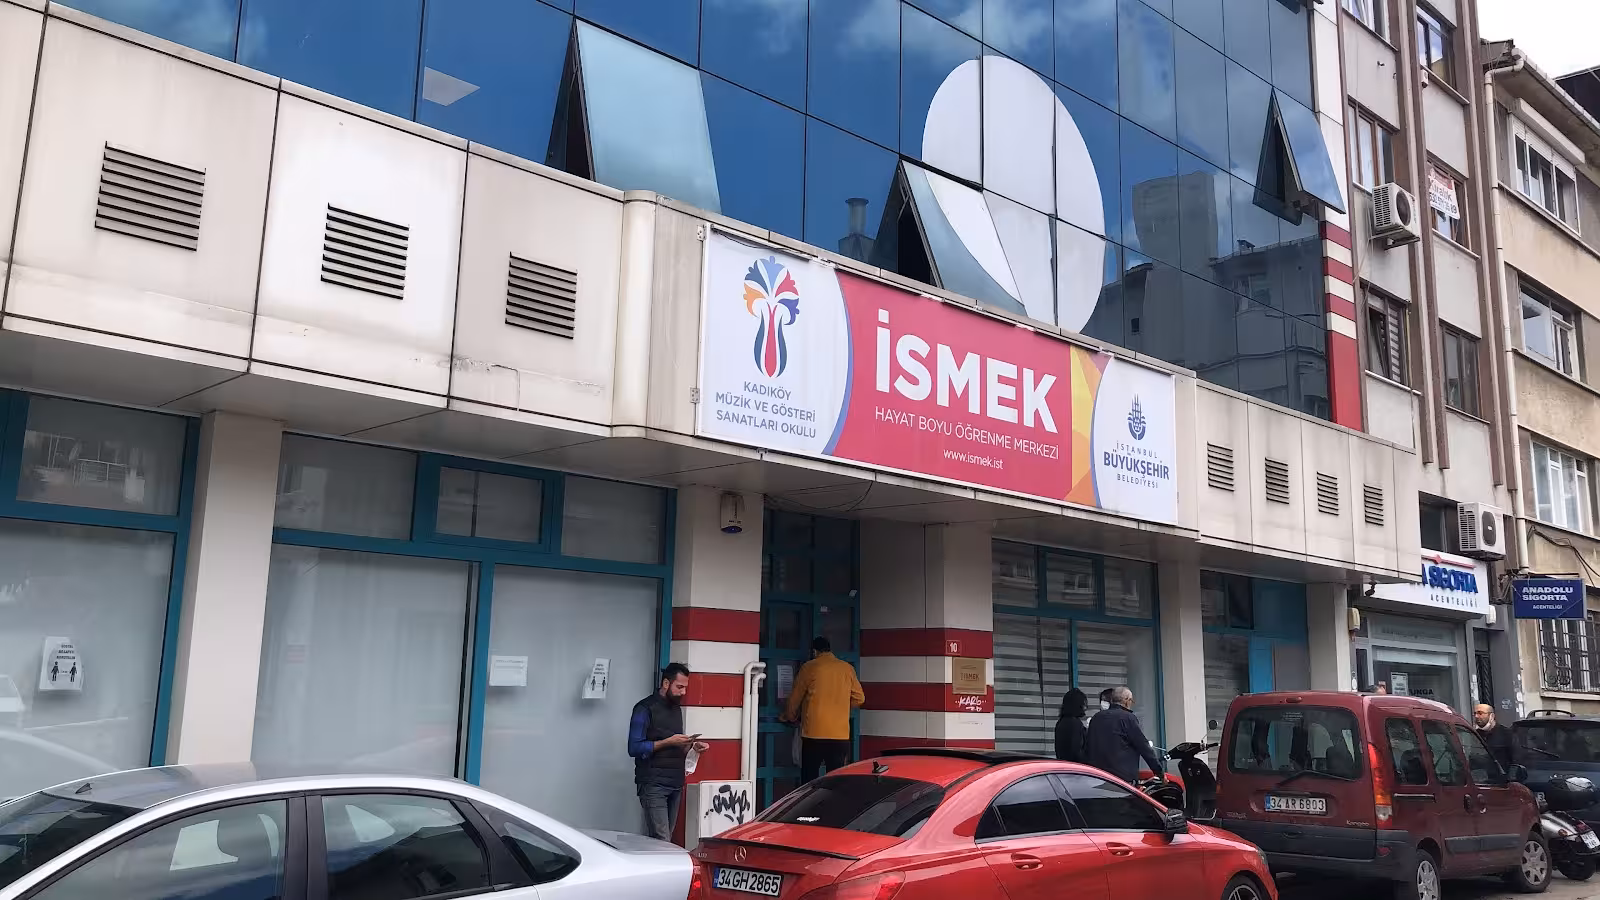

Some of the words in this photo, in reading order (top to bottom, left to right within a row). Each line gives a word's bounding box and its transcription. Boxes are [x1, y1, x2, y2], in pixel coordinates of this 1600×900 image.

[876, 308, 1058, 434] İSMEK
[743, 381, 791, 400] KADIKÖY
[715, 392, 751, 409] MÜZİK
[754, 400, 768, 412] VE
[771, 403, 816, 422] GÖSTERİ
[716, 409, 778, 431] SANATLARI
[781, 422, 816, 438] OKULU
[875, 406, 915, 427] HAYAT
[919, 416, 952, 436] BOYU
[955, 422, 1011, 449] ÖĞRENME
[1014, 438, 1059, 460] MERKEZİ
[943, 449, 1004, 469] www.ismek.ist
[1116, 440, 1158, 458] İSTANBUL
[1104, 449, 1169, 480] BÜYÜKŞEHİR
[1117, 474, 1158, 488] BELEDİYESİ
[949, 642, 958, 653] 10
[1271, 797, 1282, 809] 34
[1285, 799, 1297, 809] AR
[1299, 799, 1325, 811] 6803
